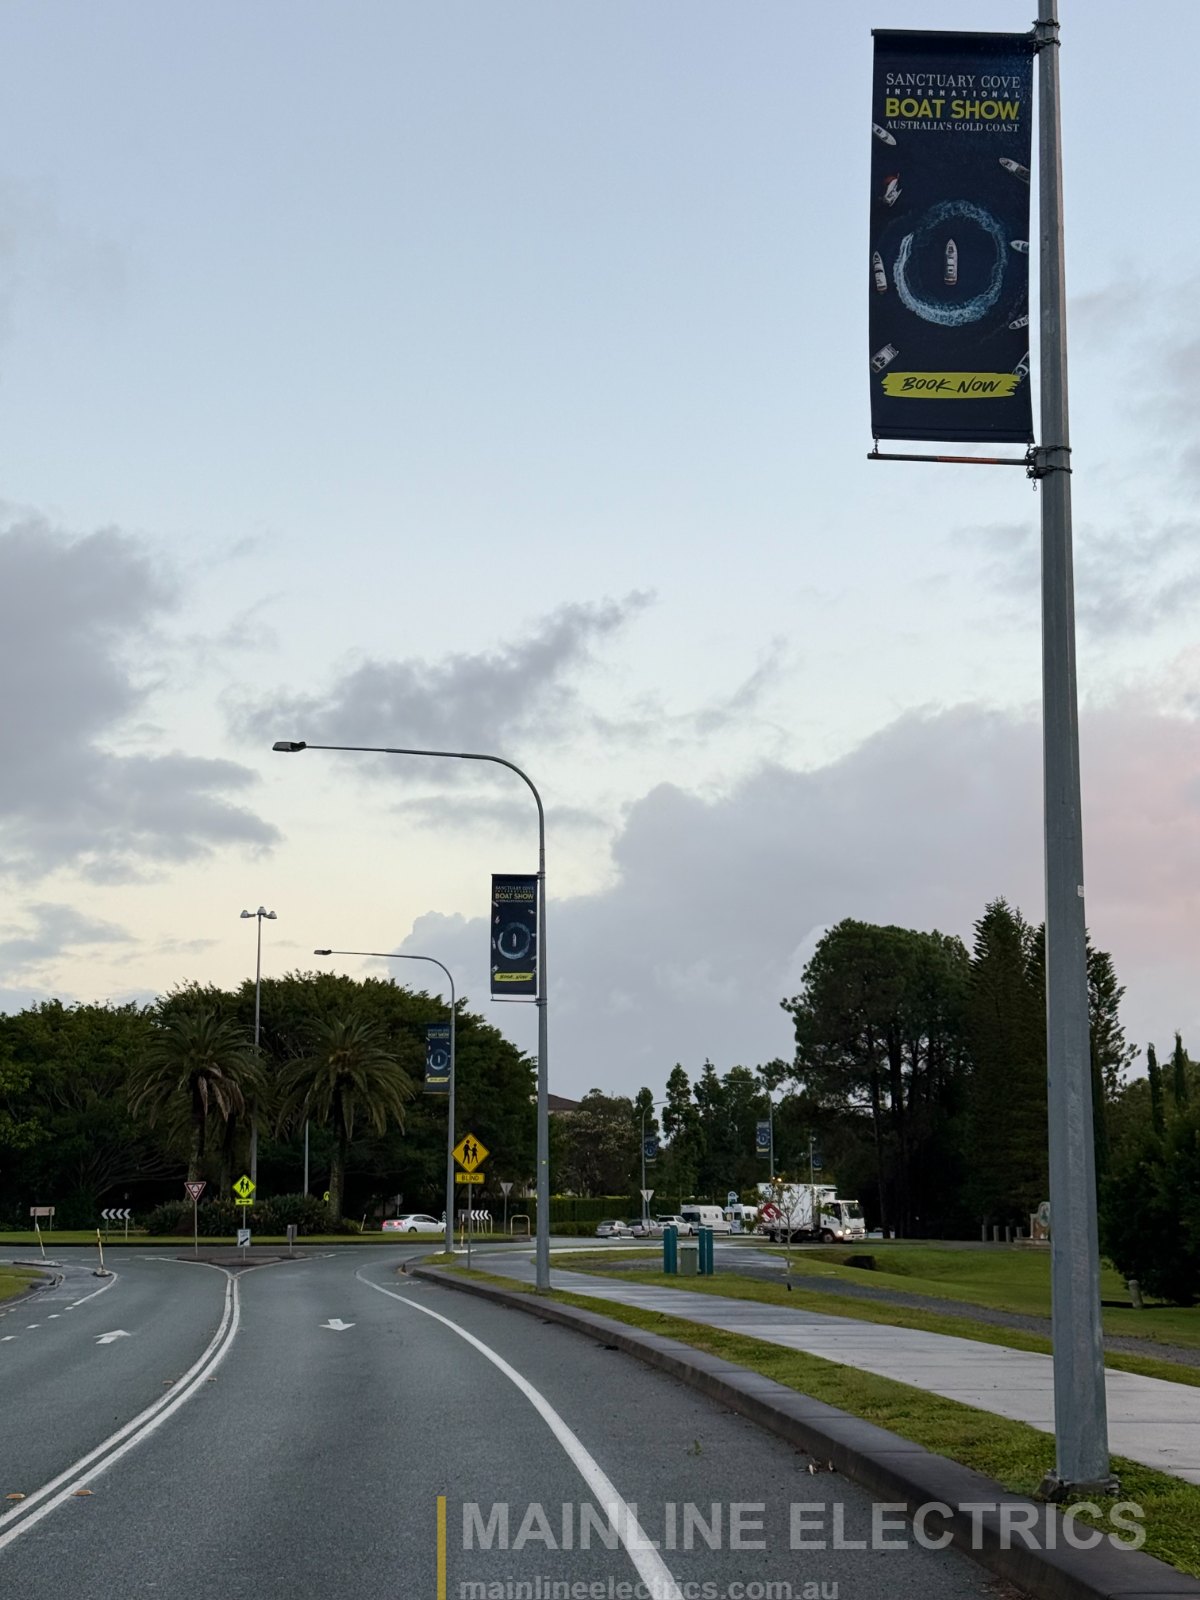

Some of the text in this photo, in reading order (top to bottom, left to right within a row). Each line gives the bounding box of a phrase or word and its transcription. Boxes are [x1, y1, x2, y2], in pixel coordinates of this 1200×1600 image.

[886, 73, 1021, 89] SANCTUARY COVE
[886, 88, 1020, 98] INTERNATIONAL
[885, 97, 1020, 120] BOAT SHOW
[886, 120, 1020, 133] AUSTRALIA'S GOLD COAST
[900, 376, 1001, 393] BOOK NOW
[495, 892, 513, 900] BOAT
